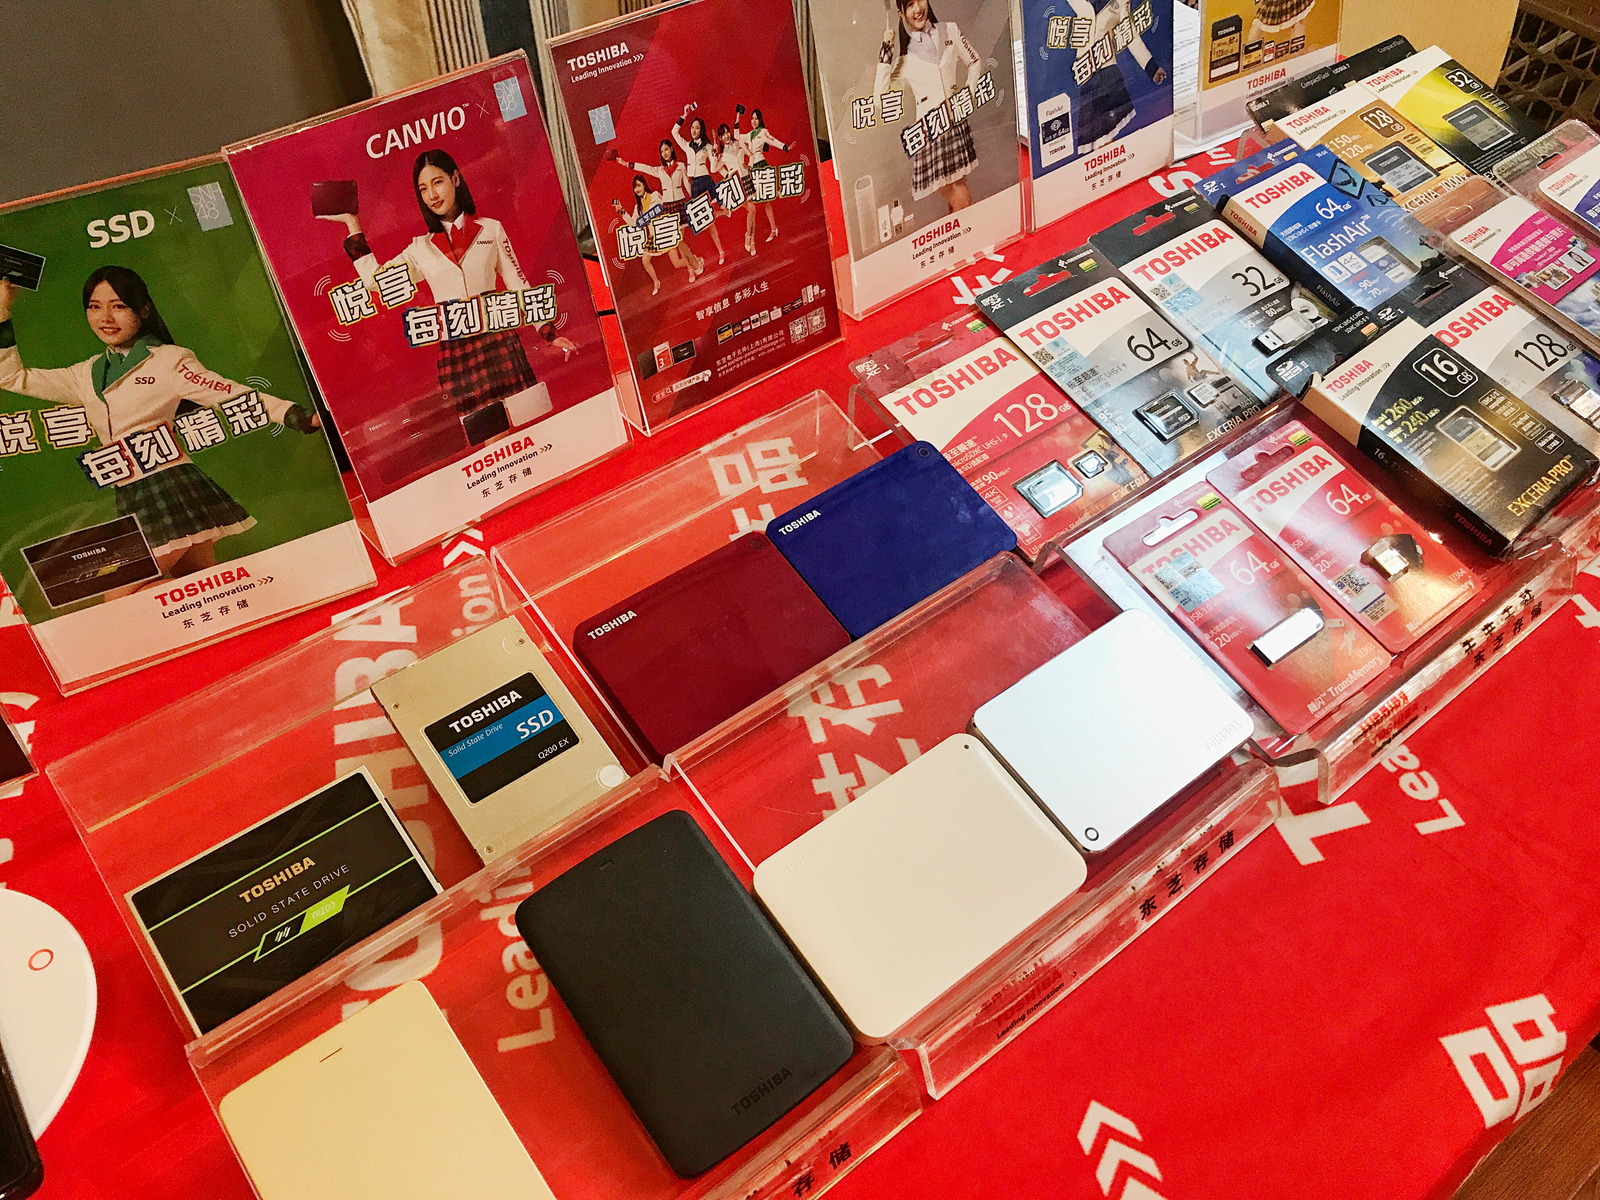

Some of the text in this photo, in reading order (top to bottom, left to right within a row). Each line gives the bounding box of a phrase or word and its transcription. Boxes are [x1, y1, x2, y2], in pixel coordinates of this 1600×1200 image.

[1047, 16, 1093, 49] 悦享
[1071, 1, 1153, 86] 每刻精彩
[567, 42, 630, 72] TOSHIBA
[571, 58, 632, 83] Leading Innovation
[1247, 67, 1286, 90] TOSHIBA
[1301, 71, 1330, 89] CompactFlash
[1366, 67, 1405, 88] TOSHIBA
[1376, 83, 1393, 94] Leading
[1448, 71, 1472, 88] 32
[850, 90, 904, 129] 悦享
[1246, 88, 1263, 100] Leading
[901, 72, 996, 157] 每刻精彩
[1286, 106, 1332, 129] TOSHIBA
[1296, 113, 1339, 136] Leading Innovation
[1363, 110, 1404, 132] 128 GB
[1329, 133, 1352, 150] 150
[1342, 143, 1365, 161] 120
[1084, 144, 1126, 172] TOSHIBA
[1085, 158, 1127, 181] Leading Innovation
[1245, 170, 1315, 209] TOSHIBA
[1402, 188, 1441, 213] XCERIA
[1438, 173, 1469, 193] 1000x
[1548, 173, 1577, 192] TOSHIBA
[616, 162, 806, 260] 悦享 每刻精彩
[1229, 209, 1258, 237] TOSHIBA
[1315, 197, 1352, 219] 64 GB
[87, 210, 155, 249] SSD
[912, 218, 961, 250] TOSHIBA
[912, 231, 962, 260] Leading Innovation
[1460, 226, 1490, 245] TOSHIBA
[502, 238, 528, 284] TOSHIBA
[1133, 227, 1234, 282] TOSHIBA
[328, 262, 418, 326] 悦享
[1231, 266, 1285, 297] 32 GB
[1316, 284, 1340, 307] FlashAir
[1359, 279, 1371, 289] 90
[1368, 287, 1381, 298] 70
[404, 283, 558, 347] 每刻精彩
[1018, 286, 1131, 347] TOSHIBA
[1243, 319, 1256, 330] 95
[1265, 307, 1277, 317] 80
[1435, 293, 1515, 348] OSHIBA
[1127, 327, 1183, 362] 64 GB
[1514, 333, 1568, 372] 128
[134, 376, 156, 385] SSD
[178, 364, 232, 395] TOSHIBA
[893, 346, 1019, 416] TOSHIBA
[1326, 359, 1375, 393] TOSHIBA
[1338, 368, 1383, 401] Leading Innovation
[1420, 353, 1473, 385] 16 GB
[993, 393, 1072, 438] 128 GB
[1098, 409, 1113, 422] 95
[1205, 404, 1261, 443] EXCERIA PRO
[1385, 397, 1413, 421] 260
[1401, 410, 1429, 434] 240
[0, 406, 95, 455] 悦享
[80, 391, 270, 487] 每刻精彩
[1111, 422, 1127, 434] 80
[461, 436, 535, 478] TOSHIBA
[1374, 447, 1386, 460] 16
[467, 450, 538, 490] Leading Innovation
[482, 466, 533, 499] 东芝存储
[982, 471, 998, 484] 90
[1244, 453, 1333, 513] TOSHIBA
[984, 489, 999, 500] 4K
[1325, 483, 1372, 515] 64 GB
[1507, 474, 1556, 517] EXCERIA
[1547, 458, 1574, 482] PRO
[778, 509, 822, 537] TOSHIBA
[1453, 512, 1493, 547] TOSHIBA
[71, 547, 107, 561] TOSHIBA
[1229, 550, 1280, 586] 64 GB
[155, 567, 251, 607] TOSHIBA
[162, 581, 256, 620] Leading Innovation
[182, 598, 250, 630] 东芝存储
[587, 609, 637, 640] TOSHIBA
[1187, 611, 1203, 624] USB
[1210, 632, 1232, 650] 120
[1473, 600, 1543, 669] 东芝存储
[1326, 654, 1384, 698] TransMemory
[449, 690, 523, 734] TOSHIBA
[516, 709, 554, 740] SSD
[448, 723, 503, 757] Solid State Drive
[538, 737, 569, 760] Q200 EX
[239, 856, 316, 904] TOSHIBA
[1139, 830, 1234, 920] 东芝存储
[229, 864, 350, 938] SOLID STATE DRIVE
[311, 901, 337, 921] TR200
[997, 982, 1064, 1039] Leading Innovation
[731, 1067, 793, 1116] TOSHIBA
